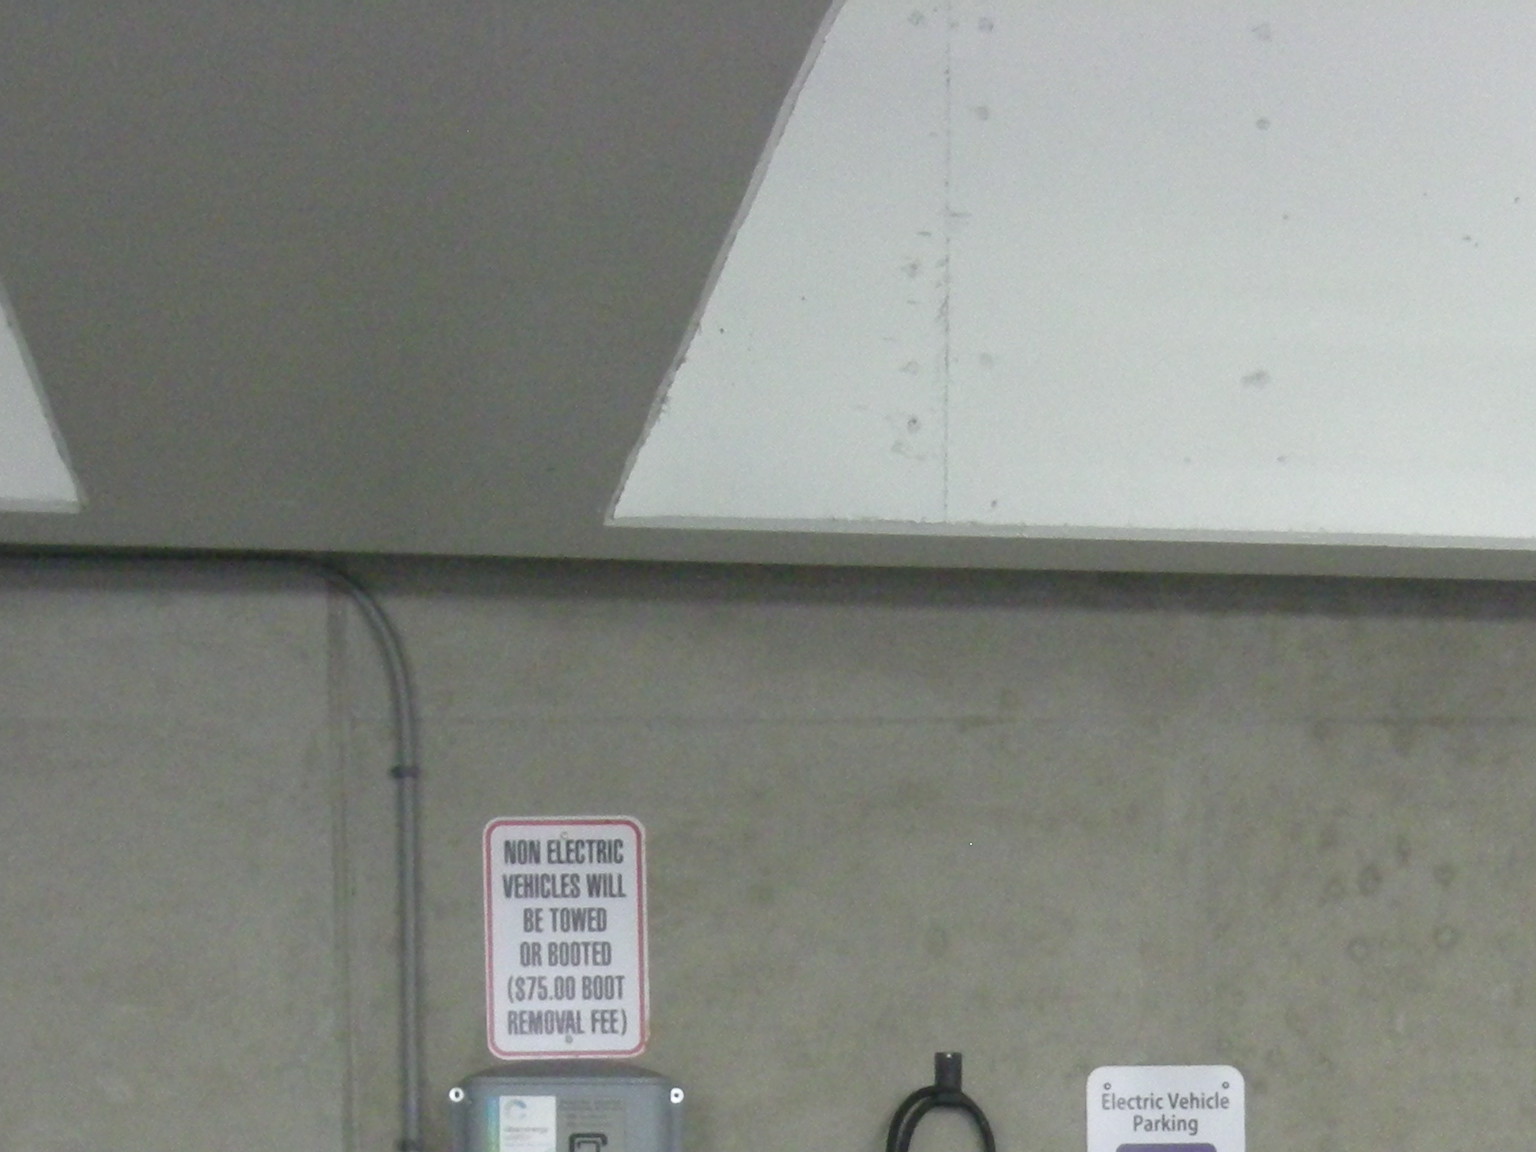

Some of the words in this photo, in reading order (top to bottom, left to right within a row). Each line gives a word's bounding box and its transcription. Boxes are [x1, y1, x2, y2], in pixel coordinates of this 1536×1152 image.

[504, 839, 541, 865] NON
[547, 839, 624, 865] ELECTRIC
[502, 873, 581, 899] VEHICLES
[586, 873, 627, 898] WILL
[523, 907, 544, 933] BE
[550, 907, 607, 933] TOWED
[520, 941, 542, 967] OR
[548, 941, 612, 967] BOOTED
[507, 975, 576, 1004] ($75.00
[582, 975, 625, 1000] BOOT
[507, 1009, 585, 1035] REMOVAL
[591, 1009, 628, 1036] FEE)
[1101, 1093, 1164, 1111] Electric
[1167, 1092, 1230, 1110] Vehicle
[1133, 1114, 1199, 1136] Parking
